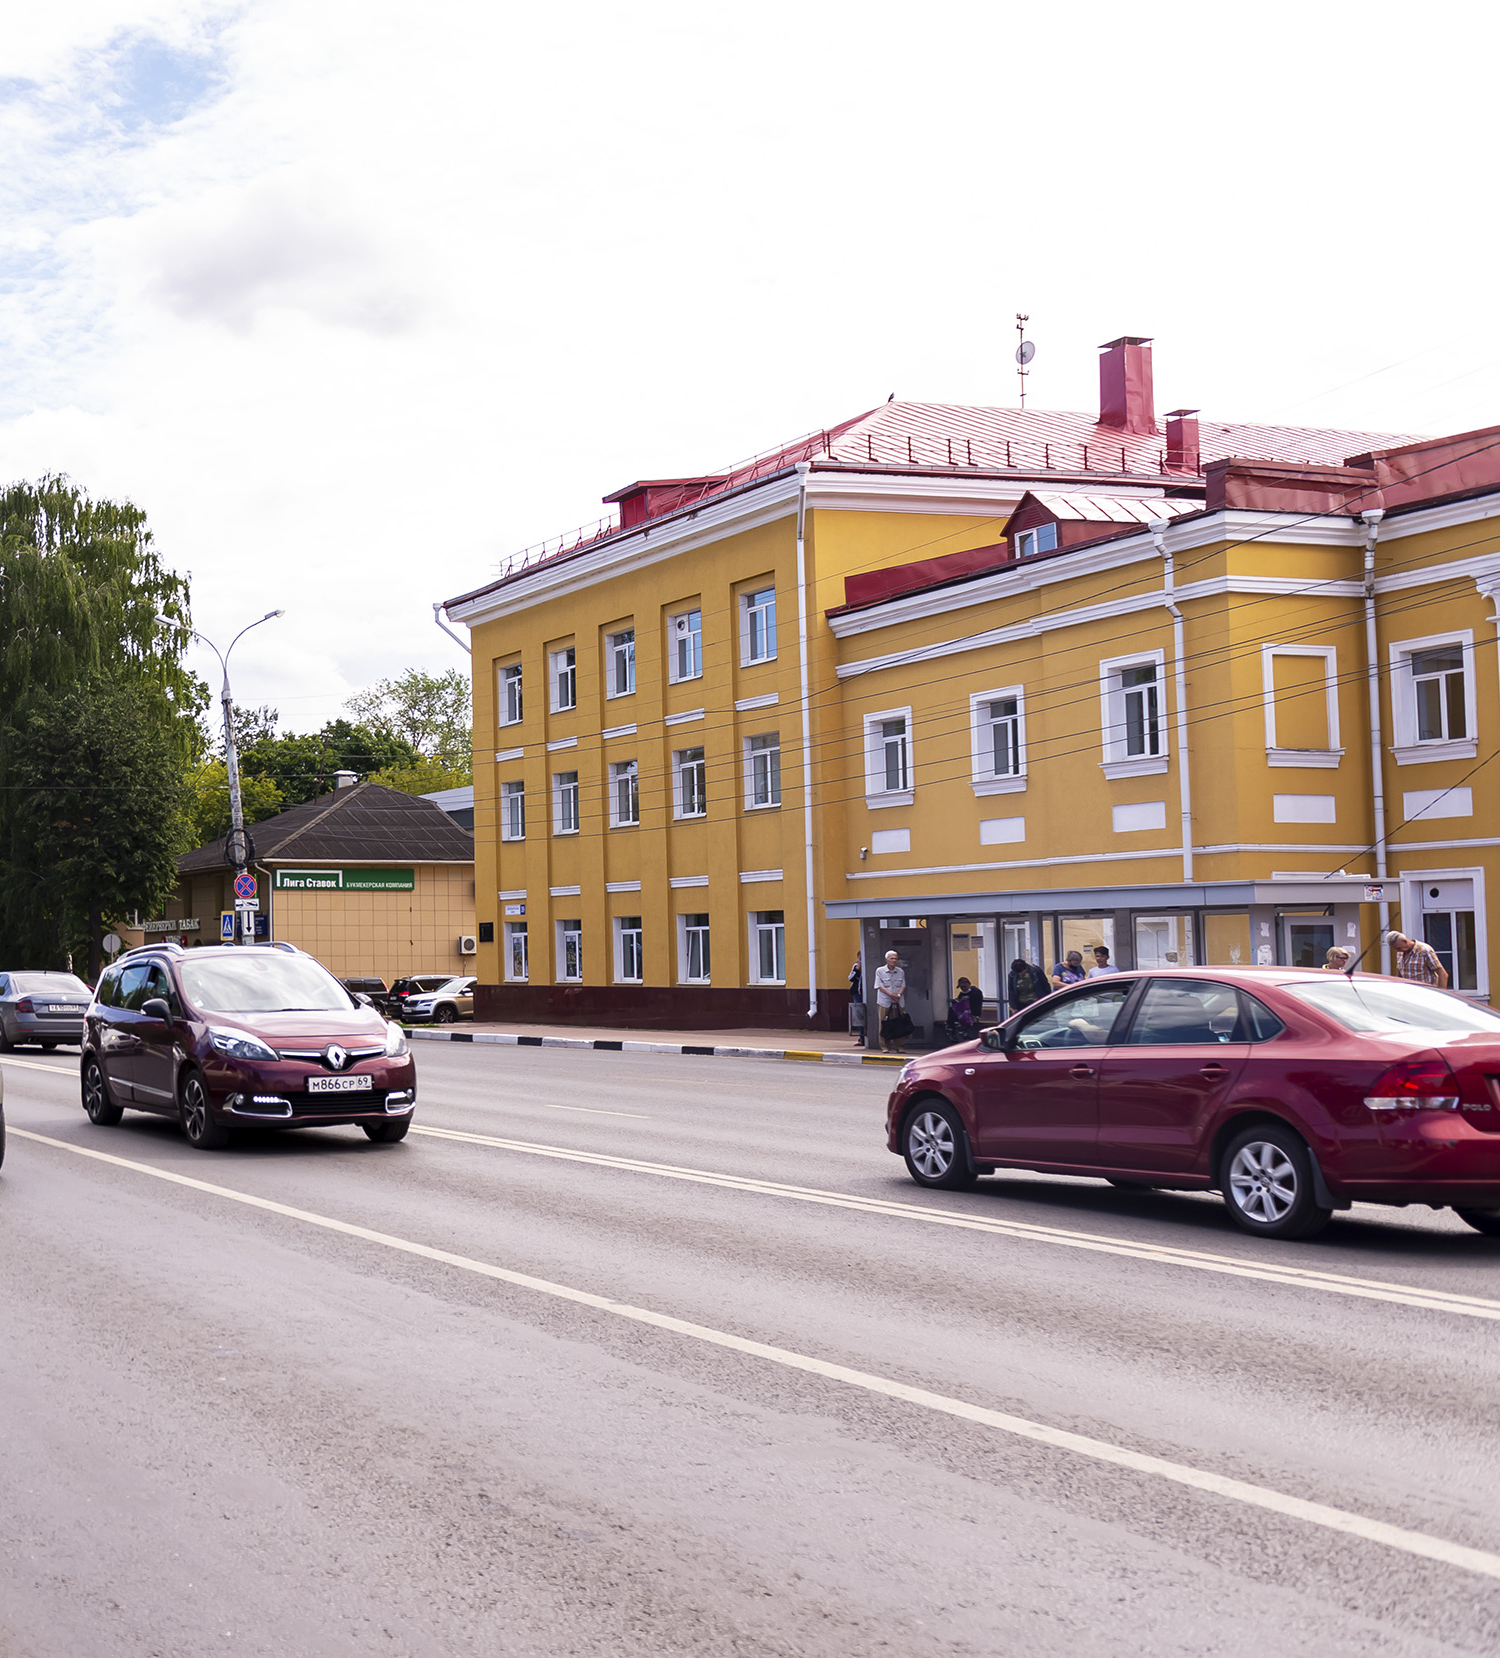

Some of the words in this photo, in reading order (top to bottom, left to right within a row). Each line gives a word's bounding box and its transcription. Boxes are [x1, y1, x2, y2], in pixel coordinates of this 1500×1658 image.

[282, 877, 305, 888] Лига
[306, 877, 337, 888] Ставок
[1462, 1103, 1491, 1111] POLO
